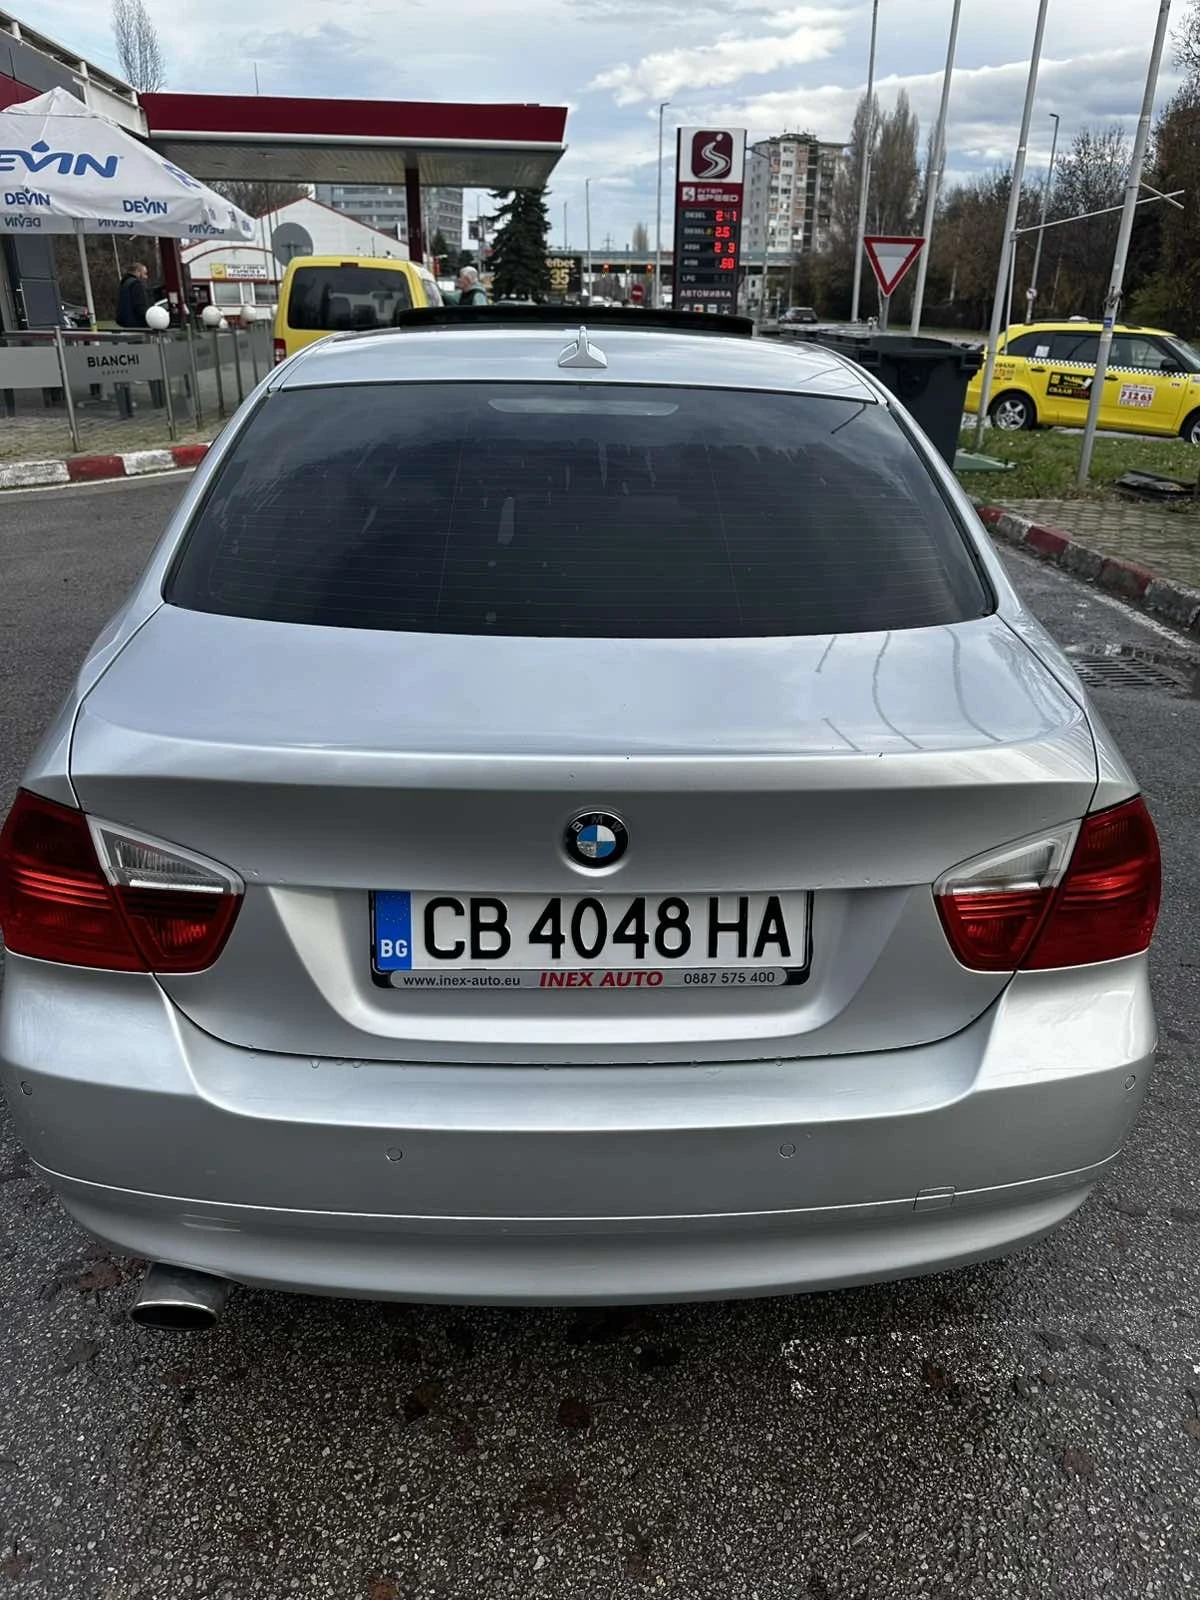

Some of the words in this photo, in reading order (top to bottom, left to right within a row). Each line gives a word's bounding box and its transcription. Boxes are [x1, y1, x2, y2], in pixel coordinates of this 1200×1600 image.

[0, 149, 118, 178] EVIN
[4, 192, 51, 206] DEVIN
[123, 199, 168, 214] DEVIN
[550, 269, 570, 285] 35
[680, 289, 732, 298] АВТОМИВКА
[87, 354, 140, 368] BIANCHI
[571, 814, 625, 833] BMW
[424, 896, 512, 960] CB
[528, 896, 692, 960] 4048
[707, 896, 792, 958] HA
[380, 939, 409, 959] BG
[403, 974, 521, 987] www.inex-auto.eu
[538, 971, 595, 987] INEX
[600, 971, 664, 987] AUTO
[683, 972, 717, 985] 0887
[721, 972, 746, 984] 575
[750, 971, 776, 983] 400
